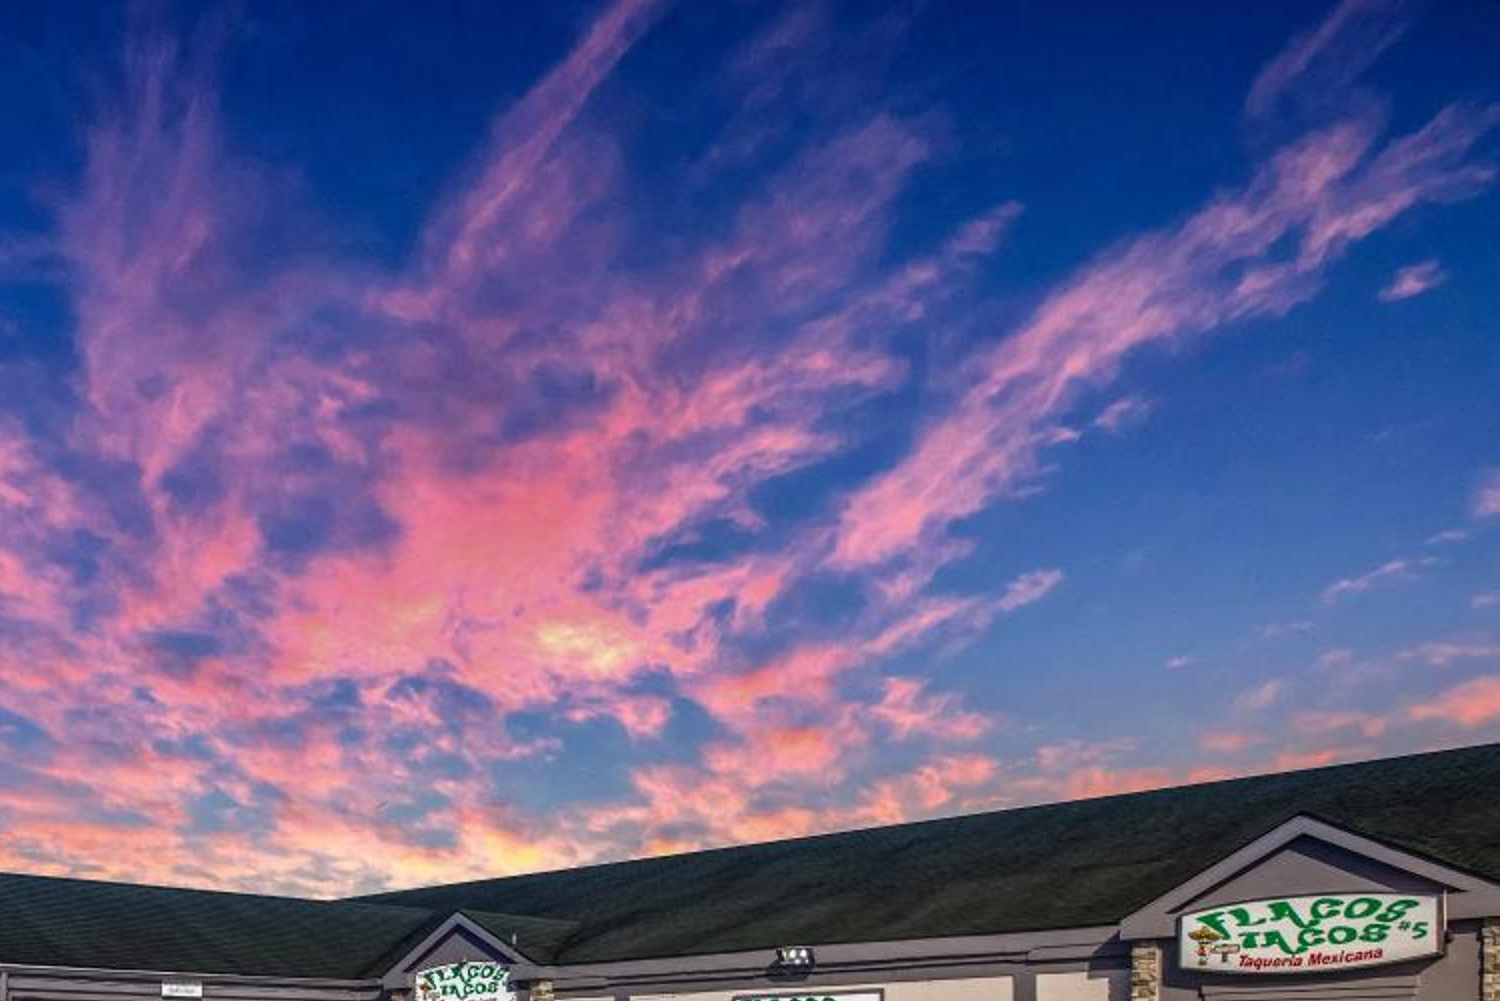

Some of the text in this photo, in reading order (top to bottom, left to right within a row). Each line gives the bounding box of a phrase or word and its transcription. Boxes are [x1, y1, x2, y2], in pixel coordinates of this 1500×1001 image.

[1196, 897, 1421, 940] FLACOS
[1238, 921, 1429, 954] TACOS #5
[1307, 949, 1383, 967] Mexicana
[424, 963, 509, 990] FLACOS
[440, 982, 497, 999] TACOS
